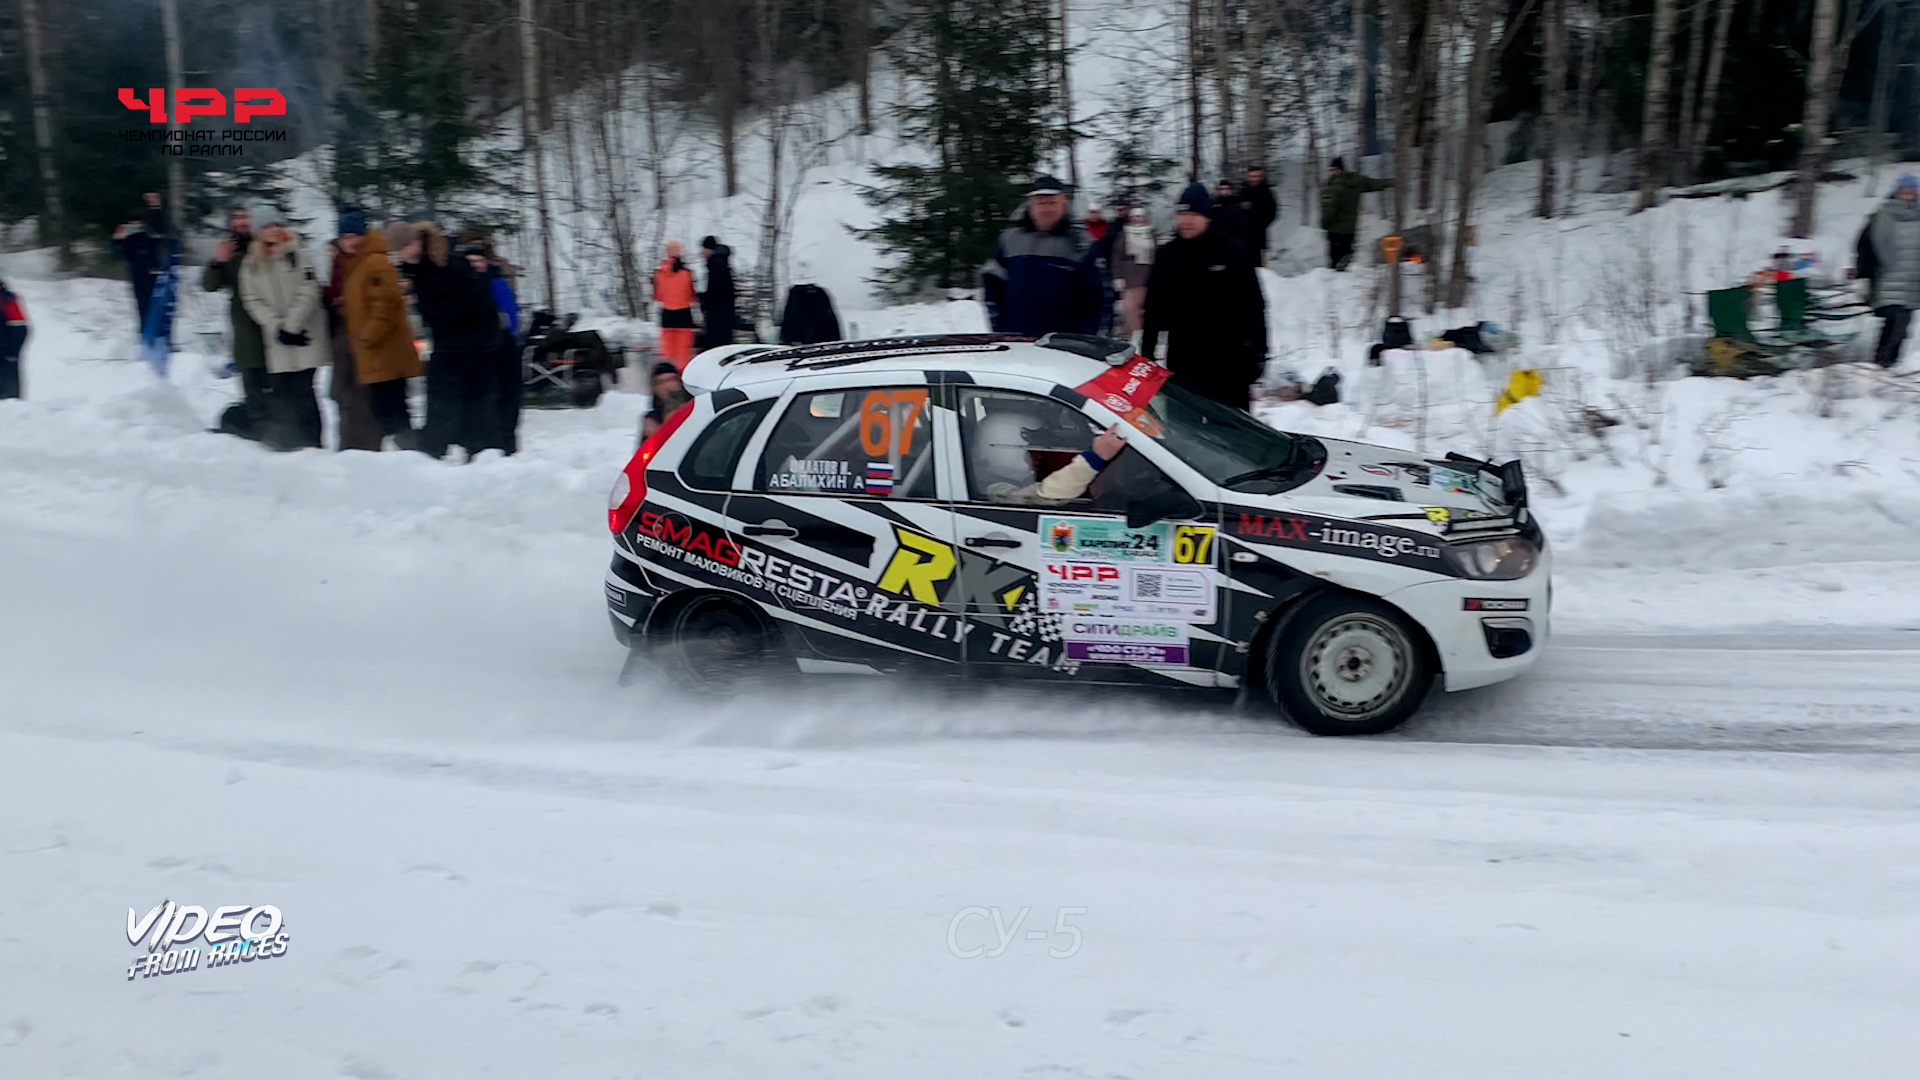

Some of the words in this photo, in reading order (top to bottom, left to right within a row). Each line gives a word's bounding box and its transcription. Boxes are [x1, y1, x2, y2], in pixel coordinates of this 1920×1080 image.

[860, 389, 928, 456] 67
[769, 473, 848, 490] АБАЛИХИН
[853, 475, 865, 490] А
[1174, 526, 1216, 563] 67
[1237, 512, 1441, 558] MAX-image.ru
[636, 533, 684, 561] РЕМОНТ
[684, 552, 763, 589] МАХОВИКОВ
[777, 586, 858, 620] СЦЕПЛЕНИЯ
[1047, 565, 1119, 581] ЧРР
[865, 593, 976, 644] RALLY
[1073, 623, 1178, 637] СИТИДРАЙВ
